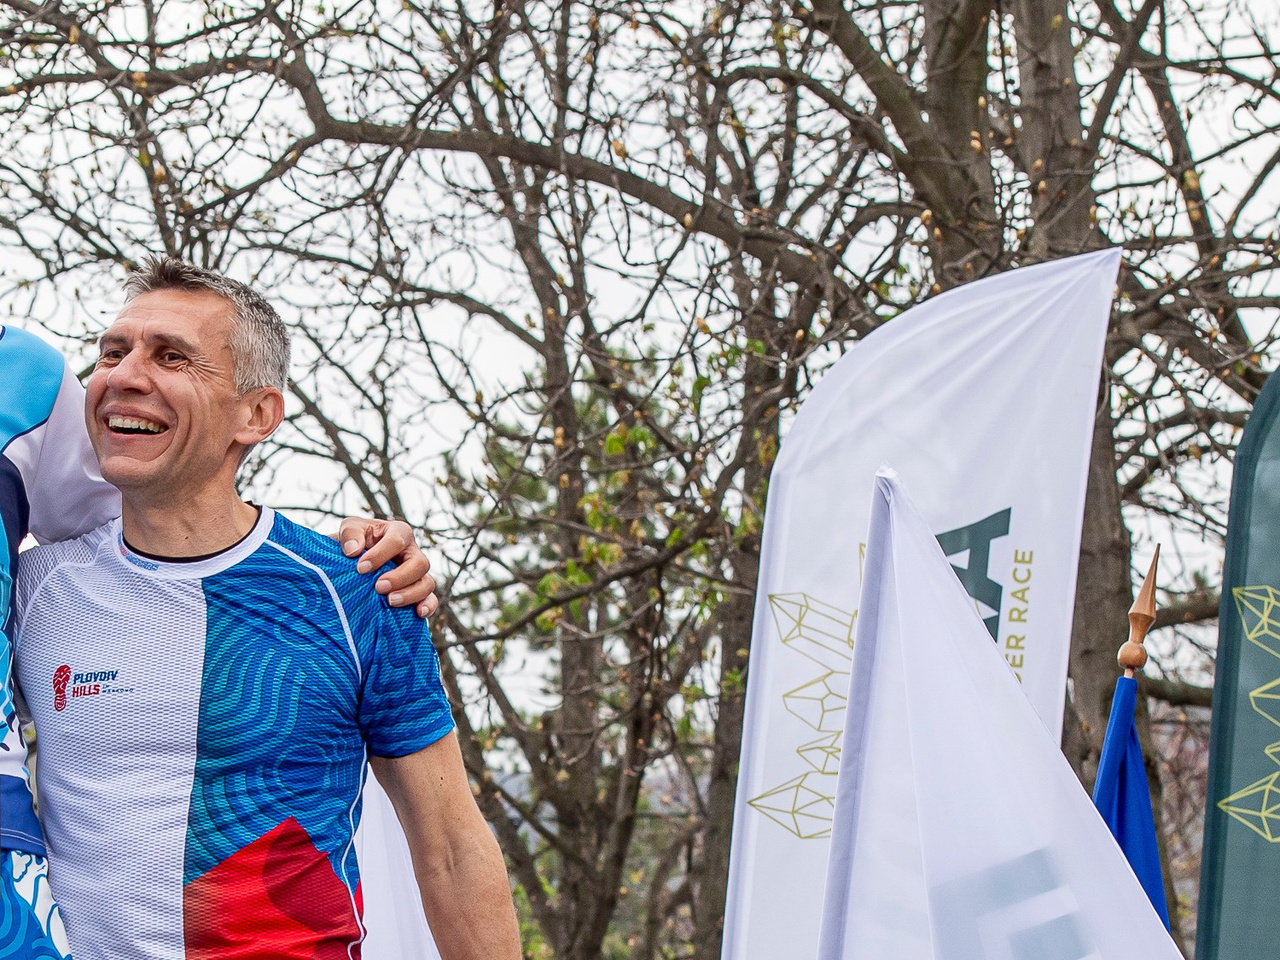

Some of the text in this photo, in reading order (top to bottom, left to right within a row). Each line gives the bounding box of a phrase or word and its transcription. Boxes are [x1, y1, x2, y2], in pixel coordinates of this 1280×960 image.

[1008, 549, 1034, 623] RACE
[73, 670, 118, 685] PLOVDIV
[72, 684, 100, 698] HILLS
